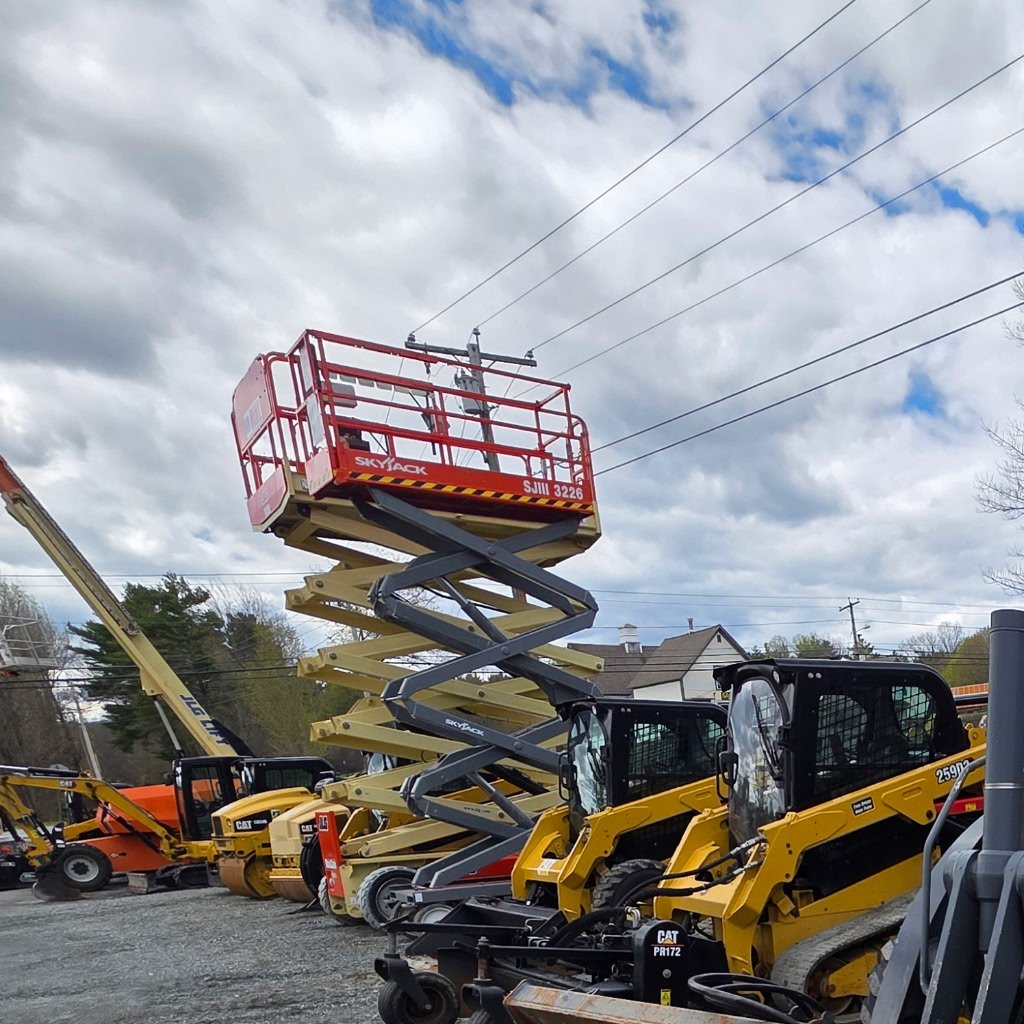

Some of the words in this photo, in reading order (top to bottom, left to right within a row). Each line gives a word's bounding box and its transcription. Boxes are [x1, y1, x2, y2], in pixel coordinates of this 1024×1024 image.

[355, 456, 428, 475] SKYJACK
[523, 480, 550, 496] SJIII
[554, 485, 584, 500] 3226
[180, 695, 206, 716] JLG
[445, 718, 484, 737] SKYJACK
[235, 820, 252, 830] CAT
[301, 824, 313, 832] CAT
[657, 930, 679, 944] CAT
[653, 946, 681, 957] PR172
